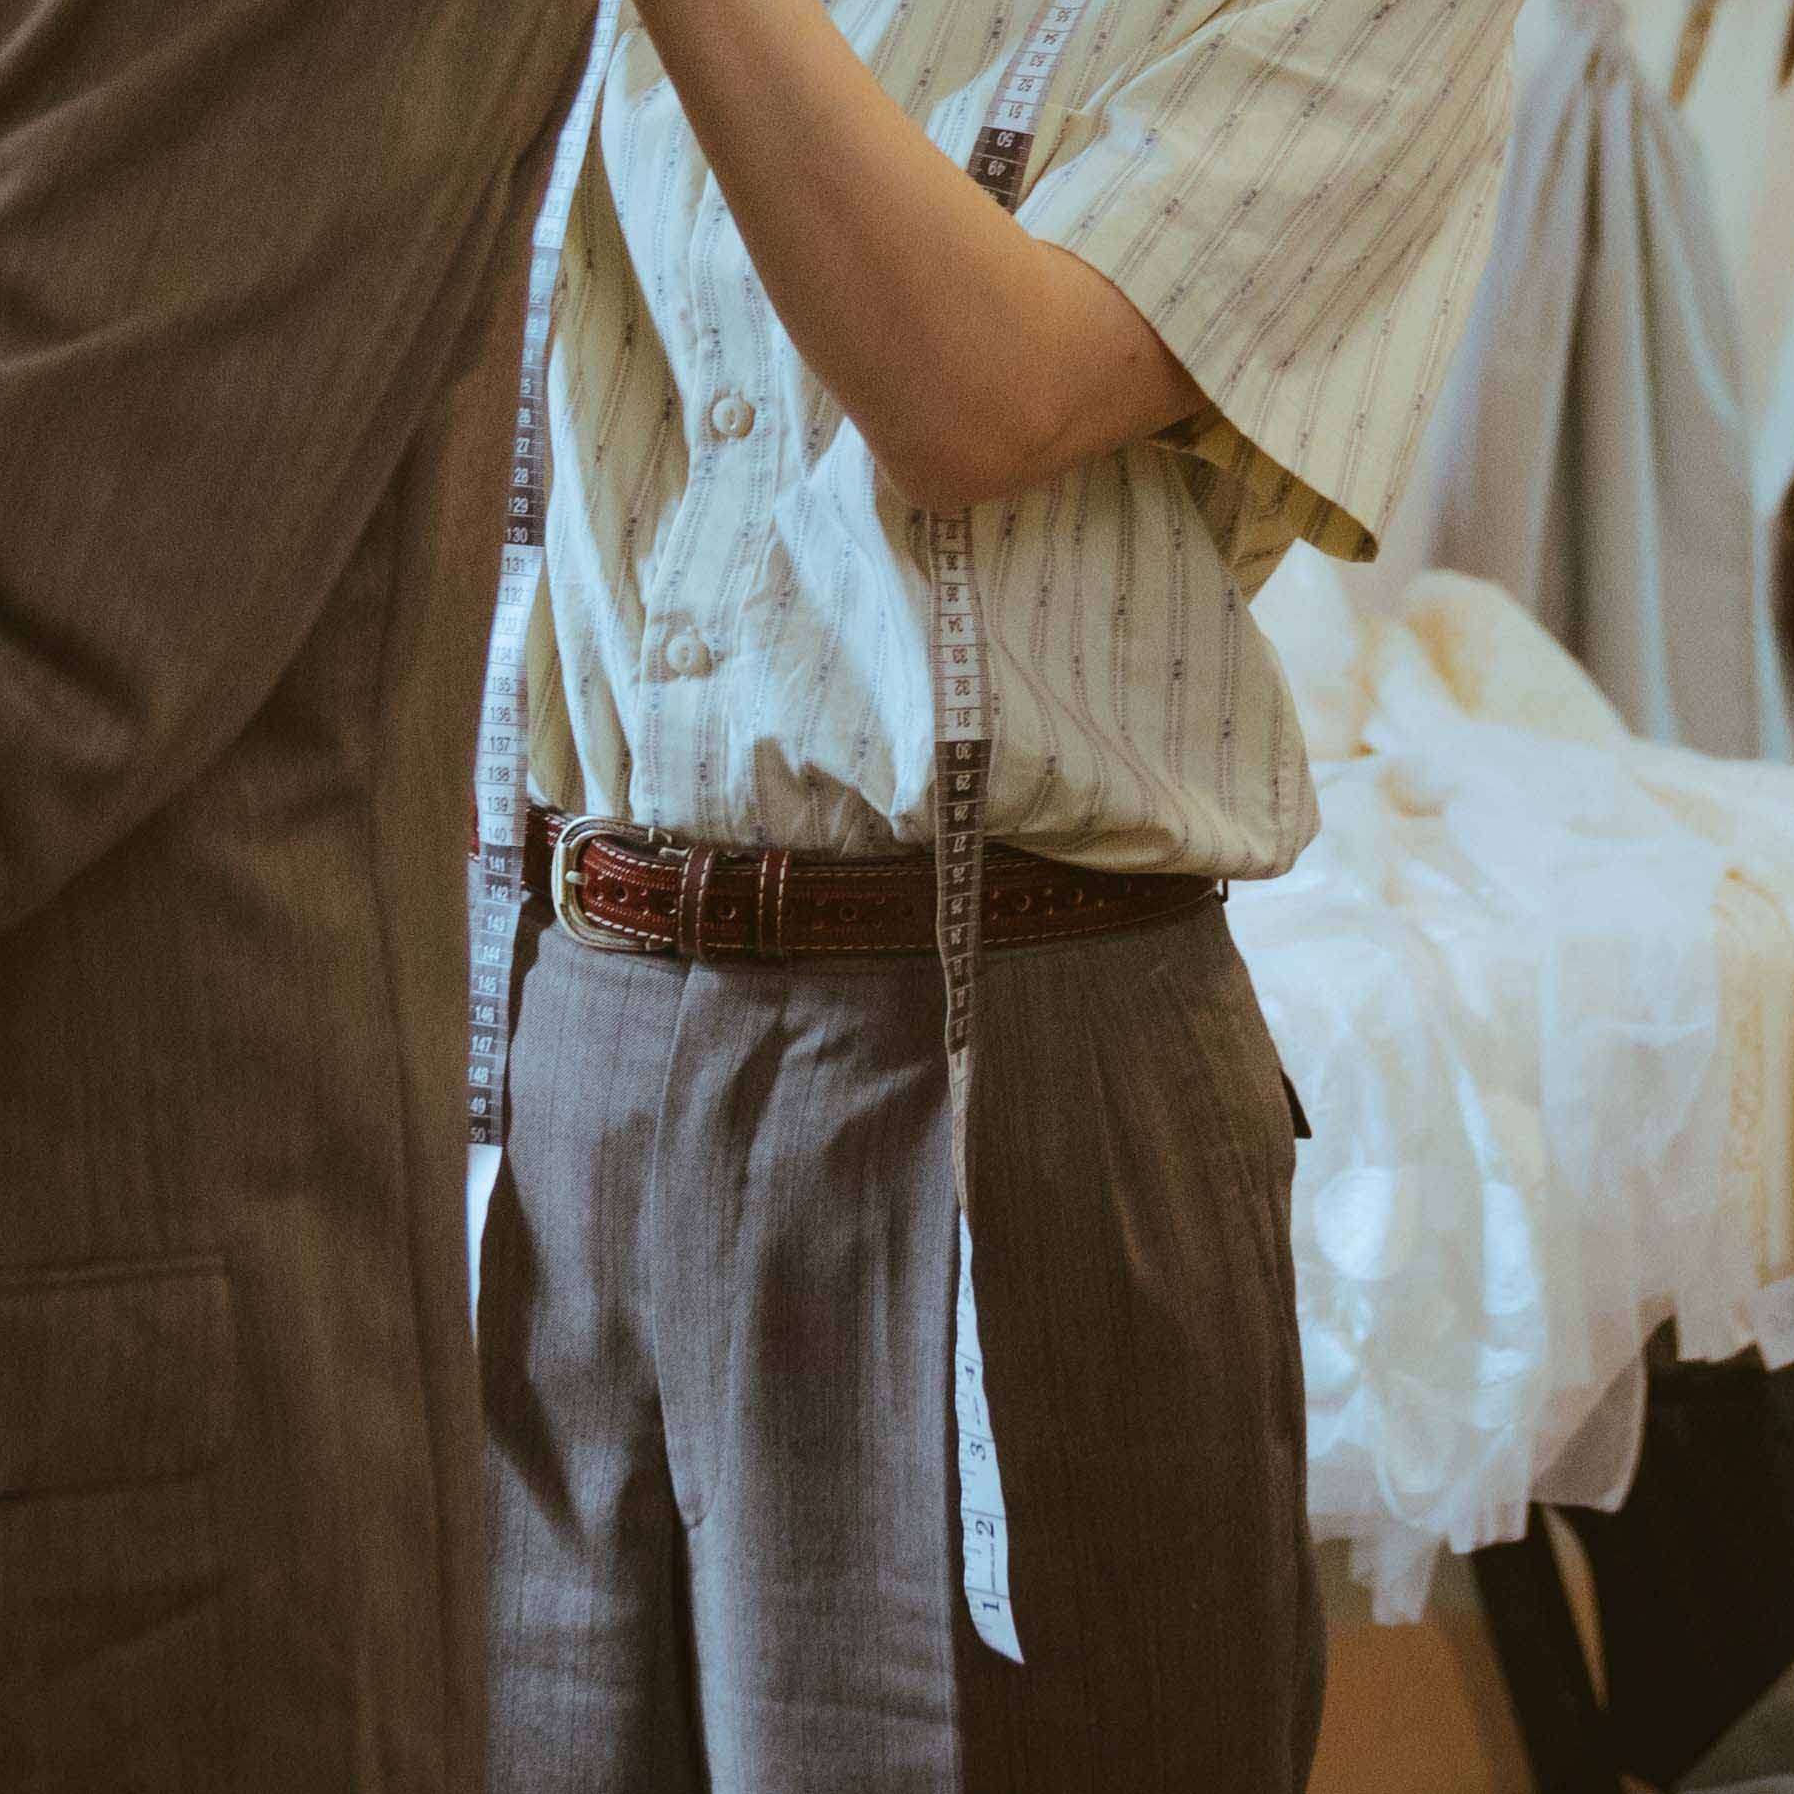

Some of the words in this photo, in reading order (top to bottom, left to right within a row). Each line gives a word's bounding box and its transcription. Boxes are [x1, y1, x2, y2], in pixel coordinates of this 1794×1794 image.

[1016, 78, 1034, 92] 52
[1007, 104, 1023, 119] 51
[996, 130, 1014, 148] 50
[987, 159, 1006, 177] 49
[517, 408, 531, 424] 26
[515, 437, 530, 454] 27
[513, 467, 529, 484] 28
[505, 527, 528, 544] 130
[505, 558, 525, 573] 131
[952, 648, 968, 664] 33
[491, 677, 511, 693] 135
[955, 679, 971, 696] 32
[489, 707, 511, 722] 136
[956, 710, 971, 728] 31
[489, 737, 511, 752] 137
[487, 766, 510, 782] 138
[487, 797, 508, 813] 139
[471, 1035, 493, 1054] 147
[470, 1097, 487, 1115] 49
[470, 1127, 487, 1143] 50
[969, 1442, 986, 1460] 3
[975, 1520, 994, 1538] 2
[983, 1601, 1000, 1612] 1
